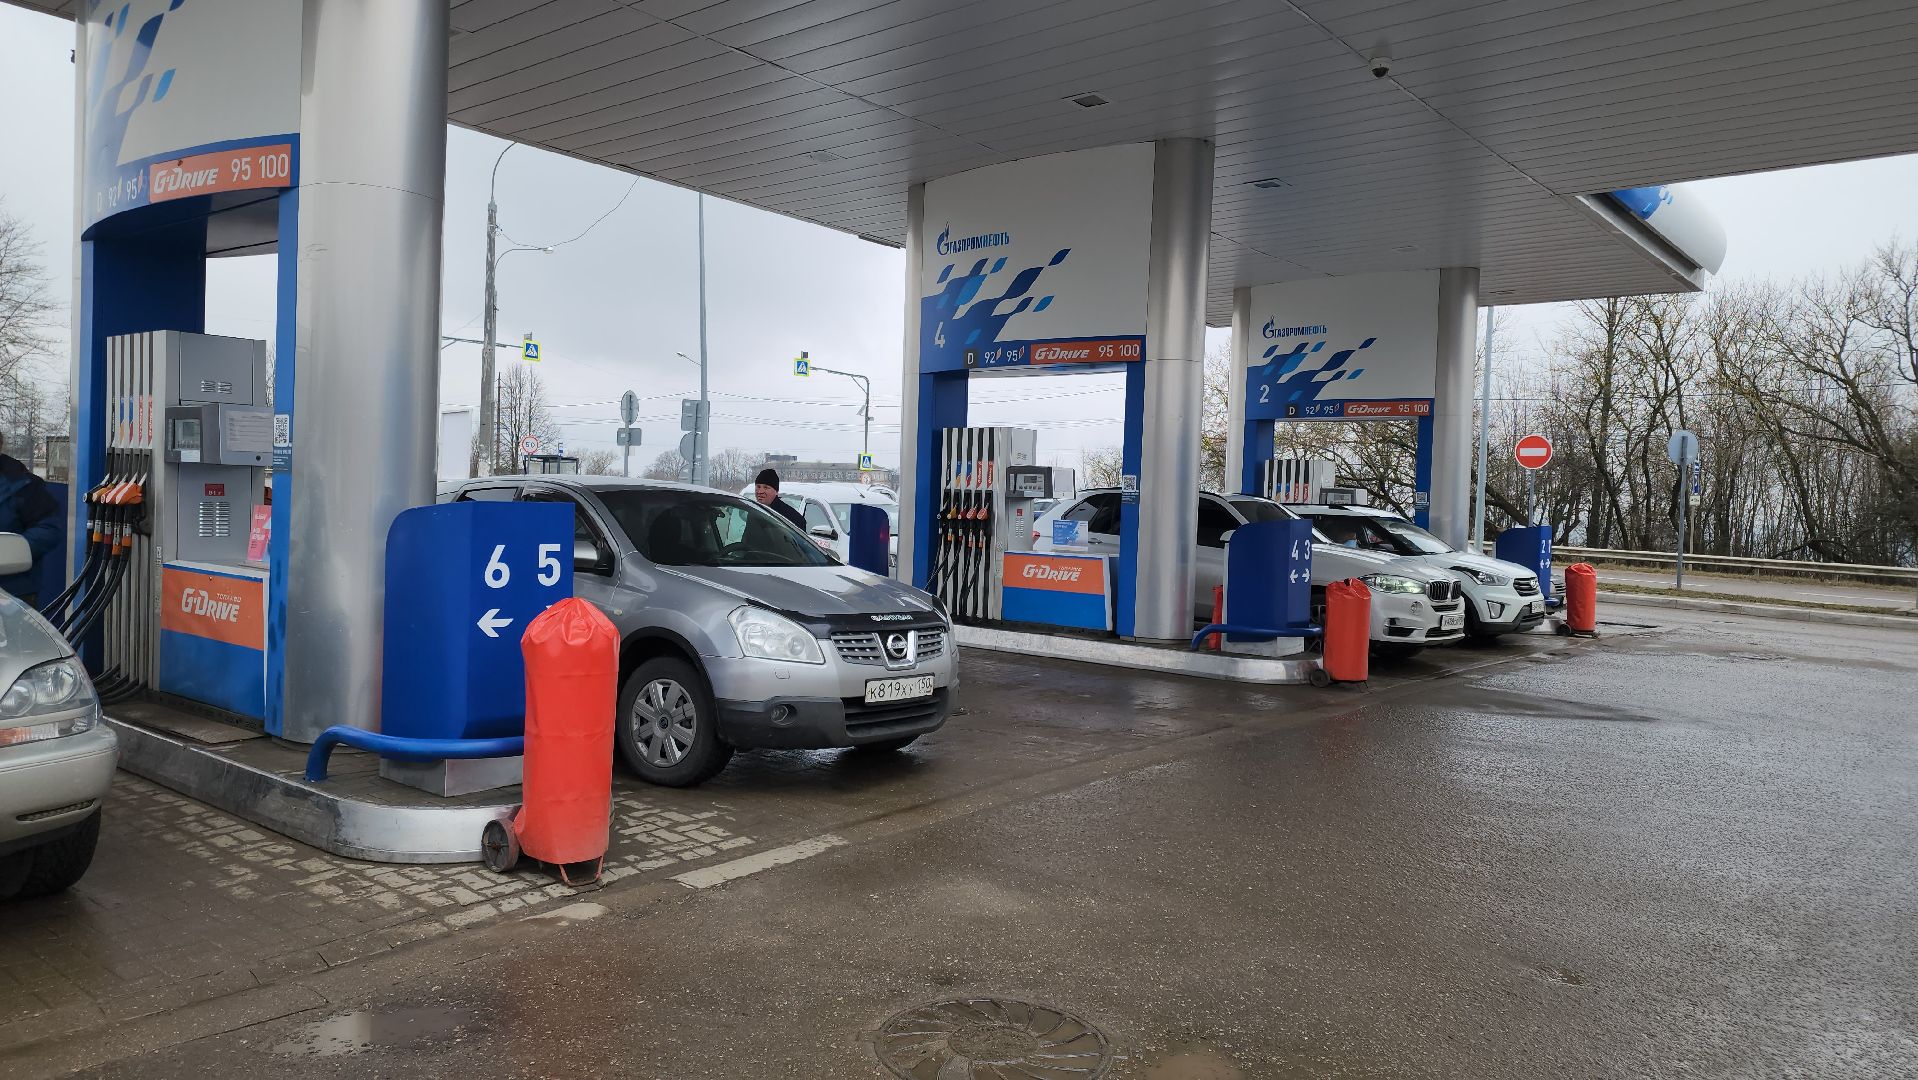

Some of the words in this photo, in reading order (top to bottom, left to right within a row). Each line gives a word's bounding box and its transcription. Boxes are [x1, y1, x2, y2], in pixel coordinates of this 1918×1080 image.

[108, 185, 117, 208] 92
[126, 177, 138, 201] 95
[231, 157, 252, 183] 95
[258, 153, 289, 180] 100
[949, 231, 1010, 255] ГАЗПРОМНЕФТЬ
[934, 321, 946, 349] 4
[967, 352, 974, 365] D
[984, 351, 996, 364] 92
[1006, 350, 1018, 362] 95
[1098, 344, 1114, 358] 95
[1118, 343, 1140, 357] 100
[1259, 384, 1270, 404] 2
[1289, 406, 1296, 416] D
[1323, 405, 1334, 414] 95
[1398, 404, 1410, 413] 95
[1413, 404, 1429, 413] 100
[1291, 539, 1299, 561] 4
[1304, 539, 1311, 560] 3
[1541, 539, 1546, 554] 2
[484, 544, 511, 589] 6
[537, 543, 561, 587] 5
